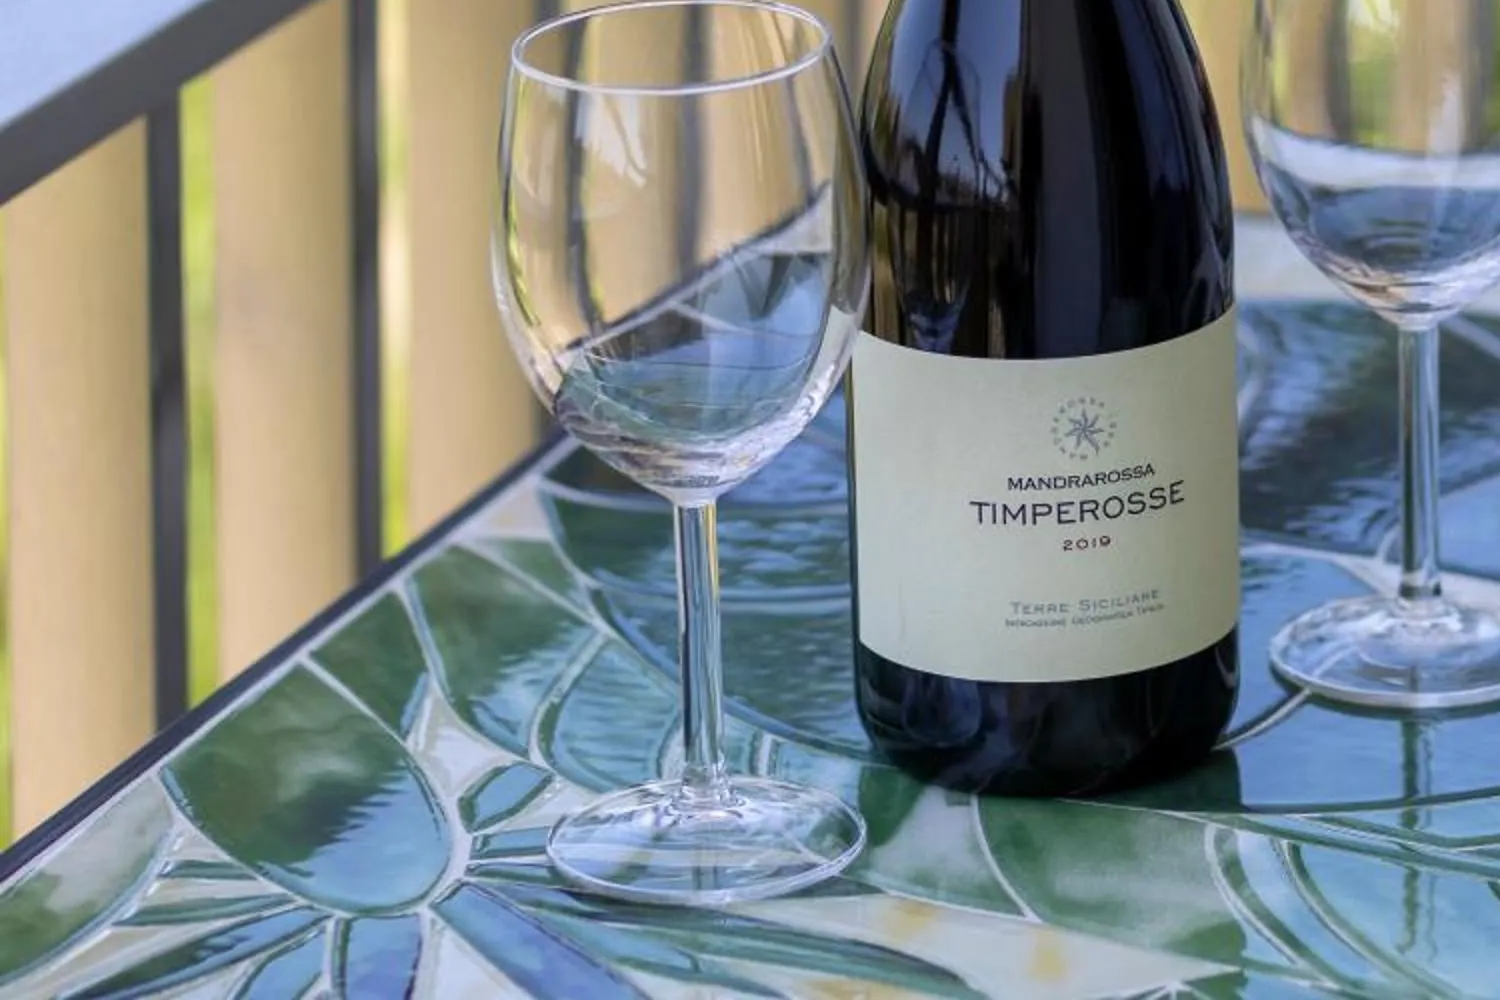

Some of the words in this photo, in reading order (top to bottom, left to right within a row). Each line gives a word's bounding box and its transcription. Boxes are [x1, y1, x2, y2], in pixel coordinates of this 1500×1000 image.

[1008, 463, 1156, 491] MANDRAROSSA
[969, 479, 1185, 526] TIMPEROSSE
[1062, 535, 1112, 552] 2019
